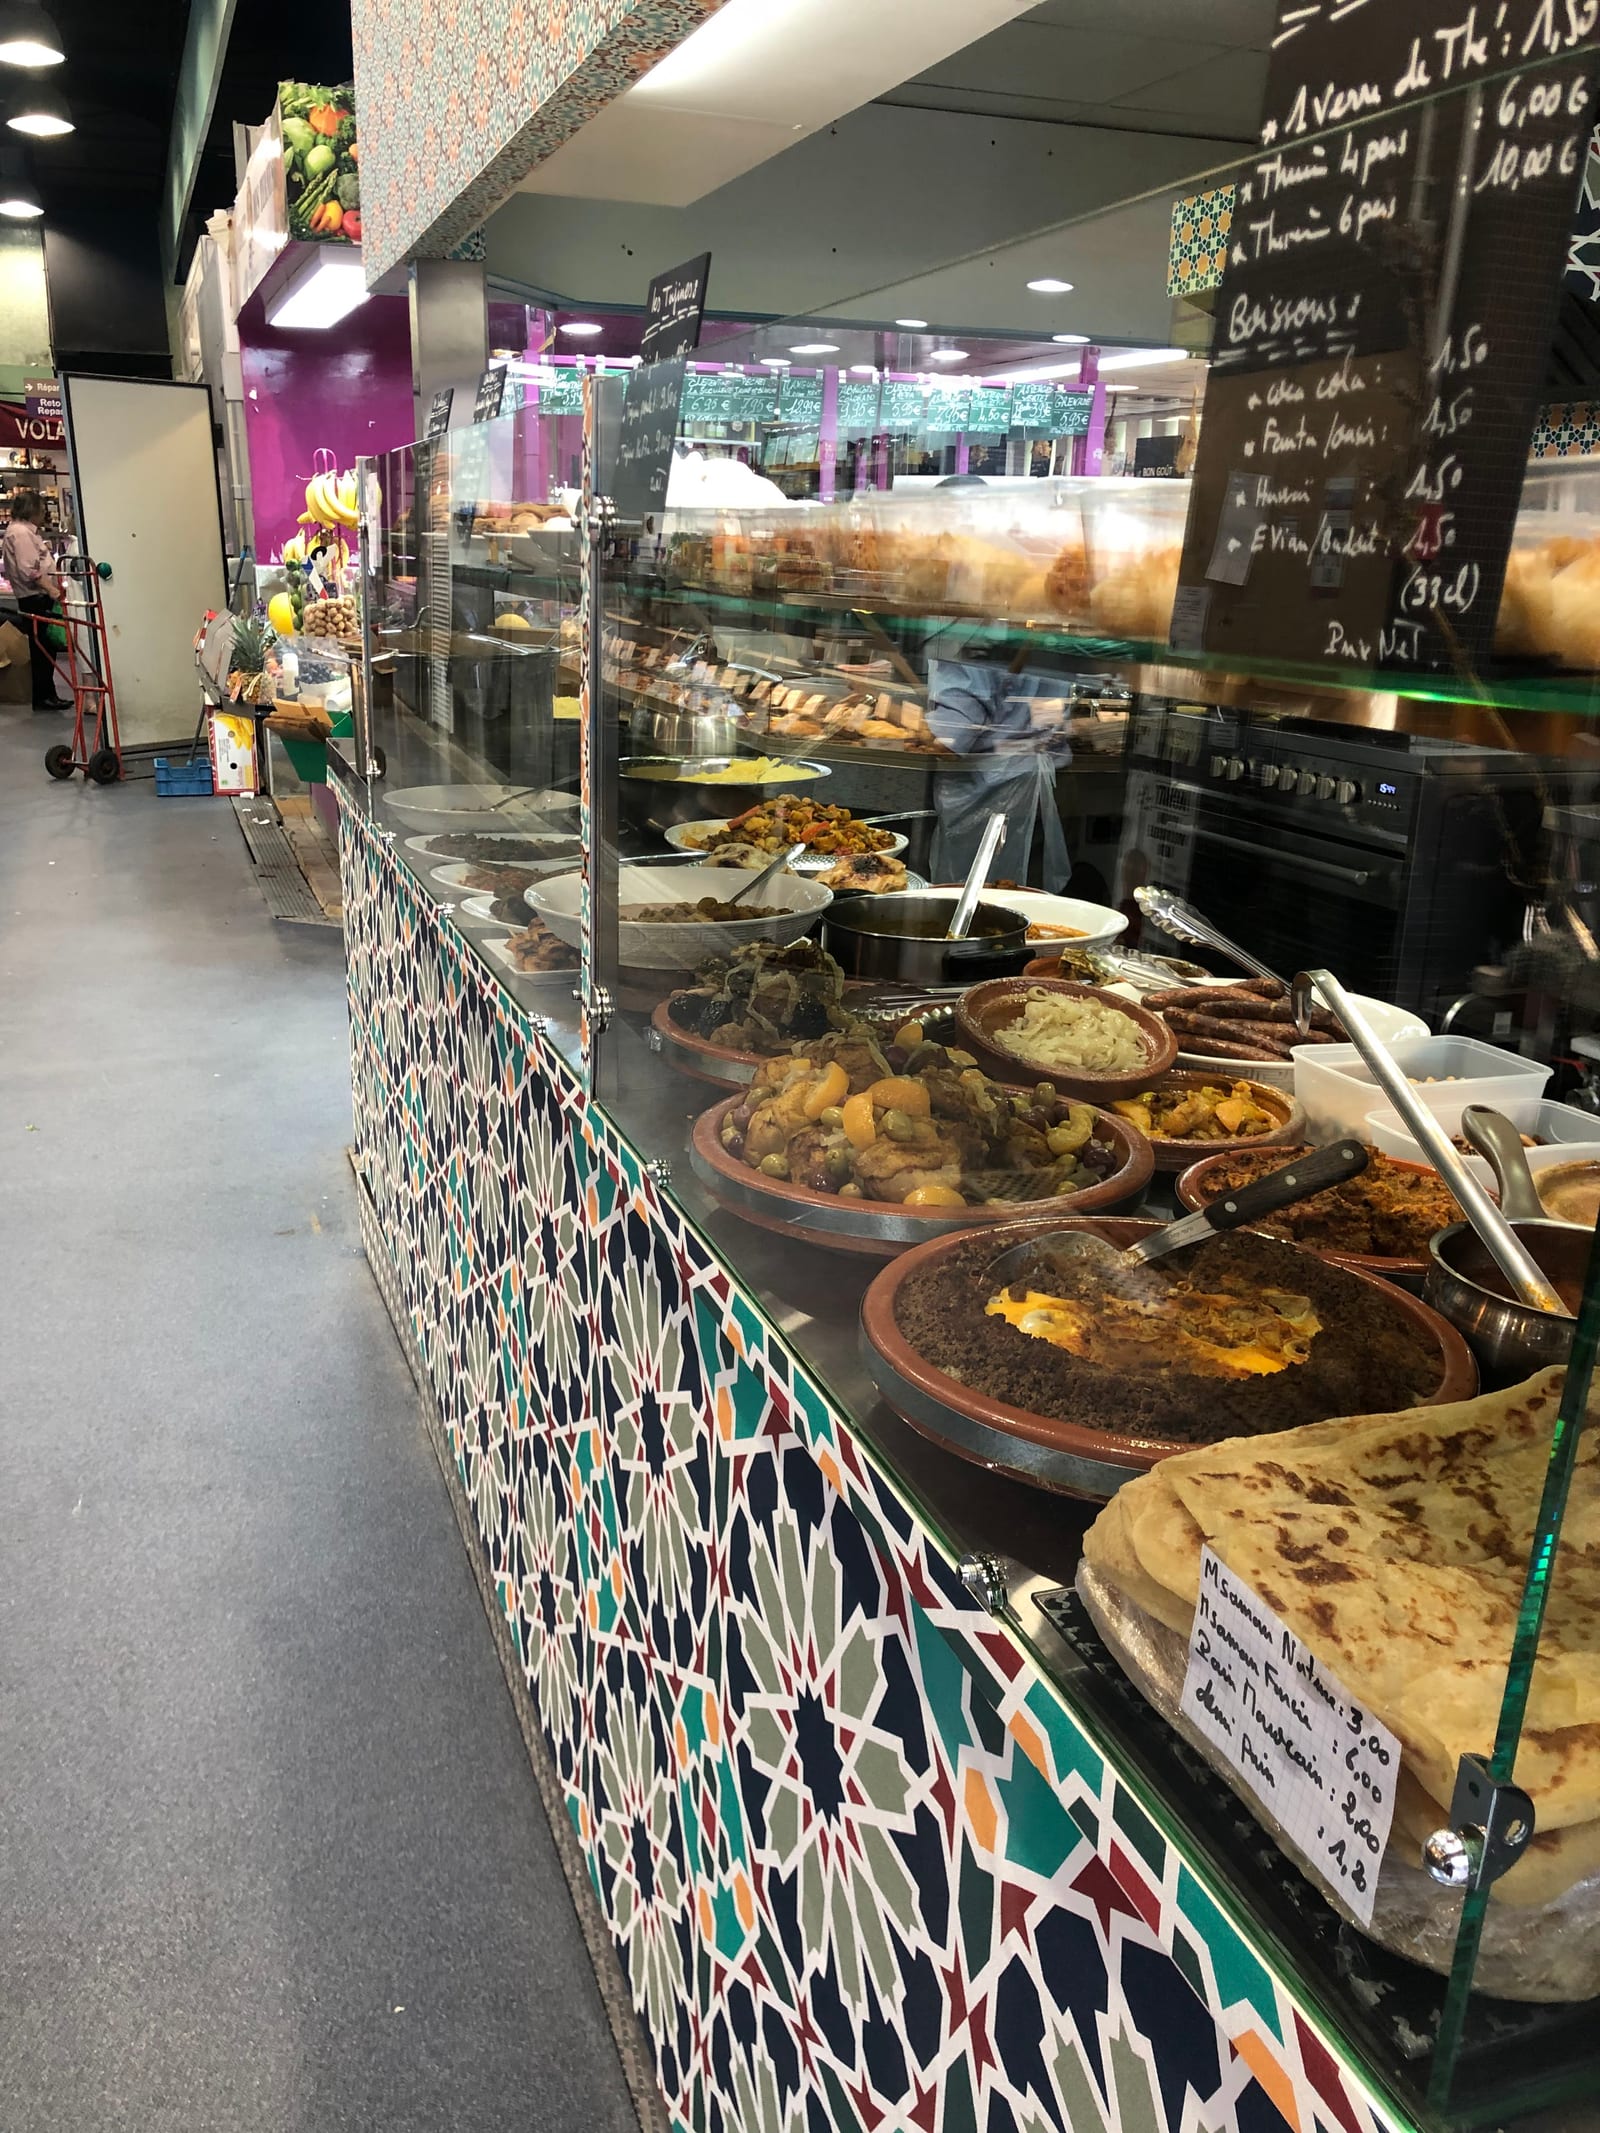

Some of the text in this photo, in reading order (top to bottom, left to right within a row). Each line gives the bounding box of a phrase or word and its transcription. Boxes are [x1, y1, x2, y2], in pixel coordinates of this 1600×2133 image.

[1394, 37, 1431, 97] de
[1499, 75, 1562, 128] 6,00
[1473, 139, 1553, 192] 10,00
[1229, 292, 1338, 344] Boissons
[1430, 323, 1488, 374] 1,50
[1263, 416, 1317, 454] Fanta
[1421, 387, 1473, 439] 1,50
[1404, 455, 1463, 501] 1,50
[1402, 512, 1457, 556] 1,50
